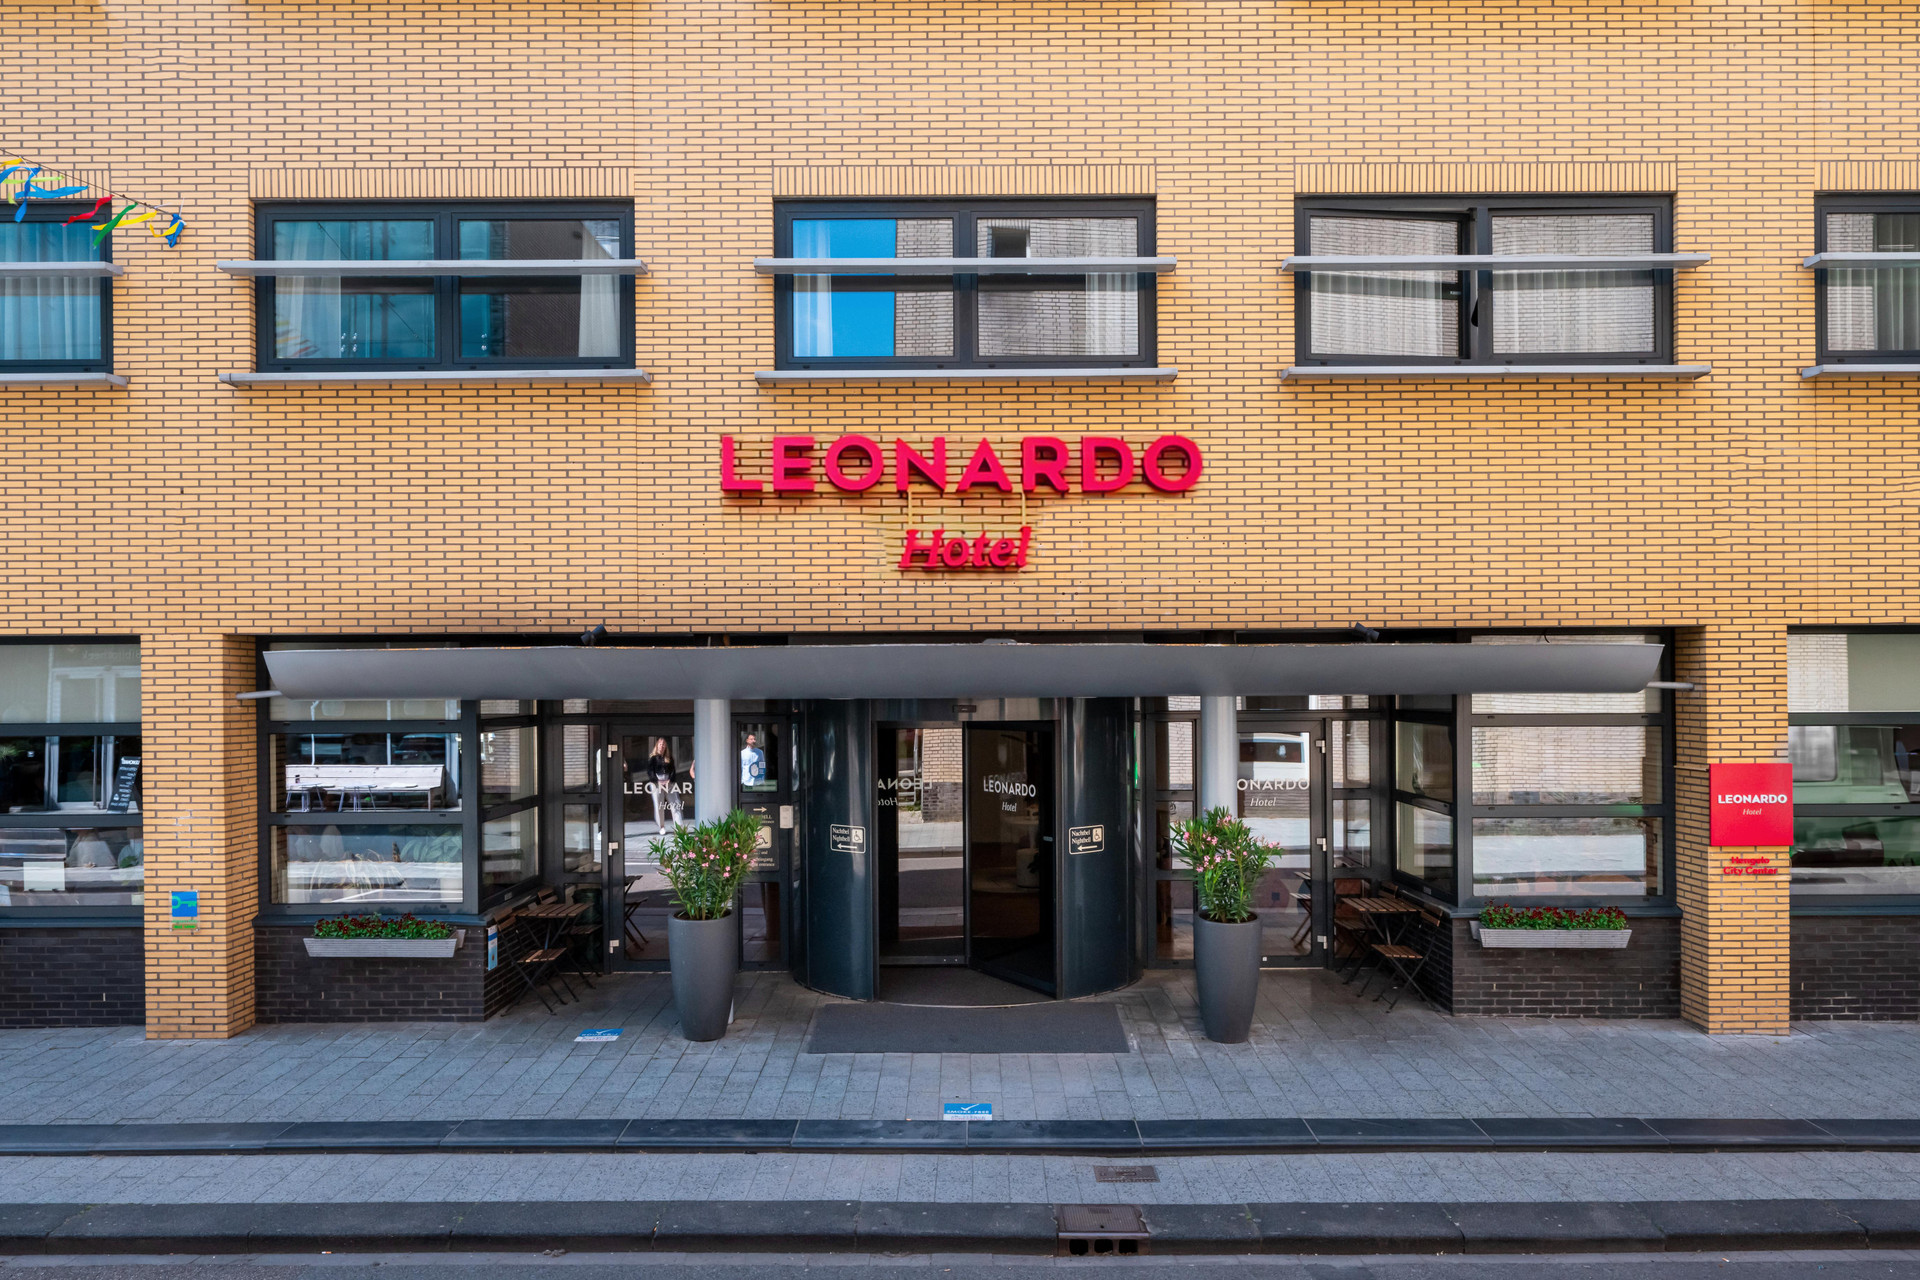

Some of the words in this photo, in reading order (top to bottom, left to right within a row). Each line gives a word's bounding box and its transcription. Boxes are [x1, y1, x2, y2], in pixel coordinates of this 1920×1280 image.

[721, 434, 1204, 492] LEONARDO
[898, 525, 1032, 568] Hotel
[983, 779, 1037, 798] LEONARDO
[1249, 797, 1277, 807] Hotel
[1717, 794, 1788, 804] LEONARDO
[658, 800, 685, 811] Hotel
[1001, 801, 1018, 812] Hotel
[1731, 856, 1770, 866] Hengelo
[1723, 866, 1744, 876] City
[1745, 866, 1779, 876] Center
